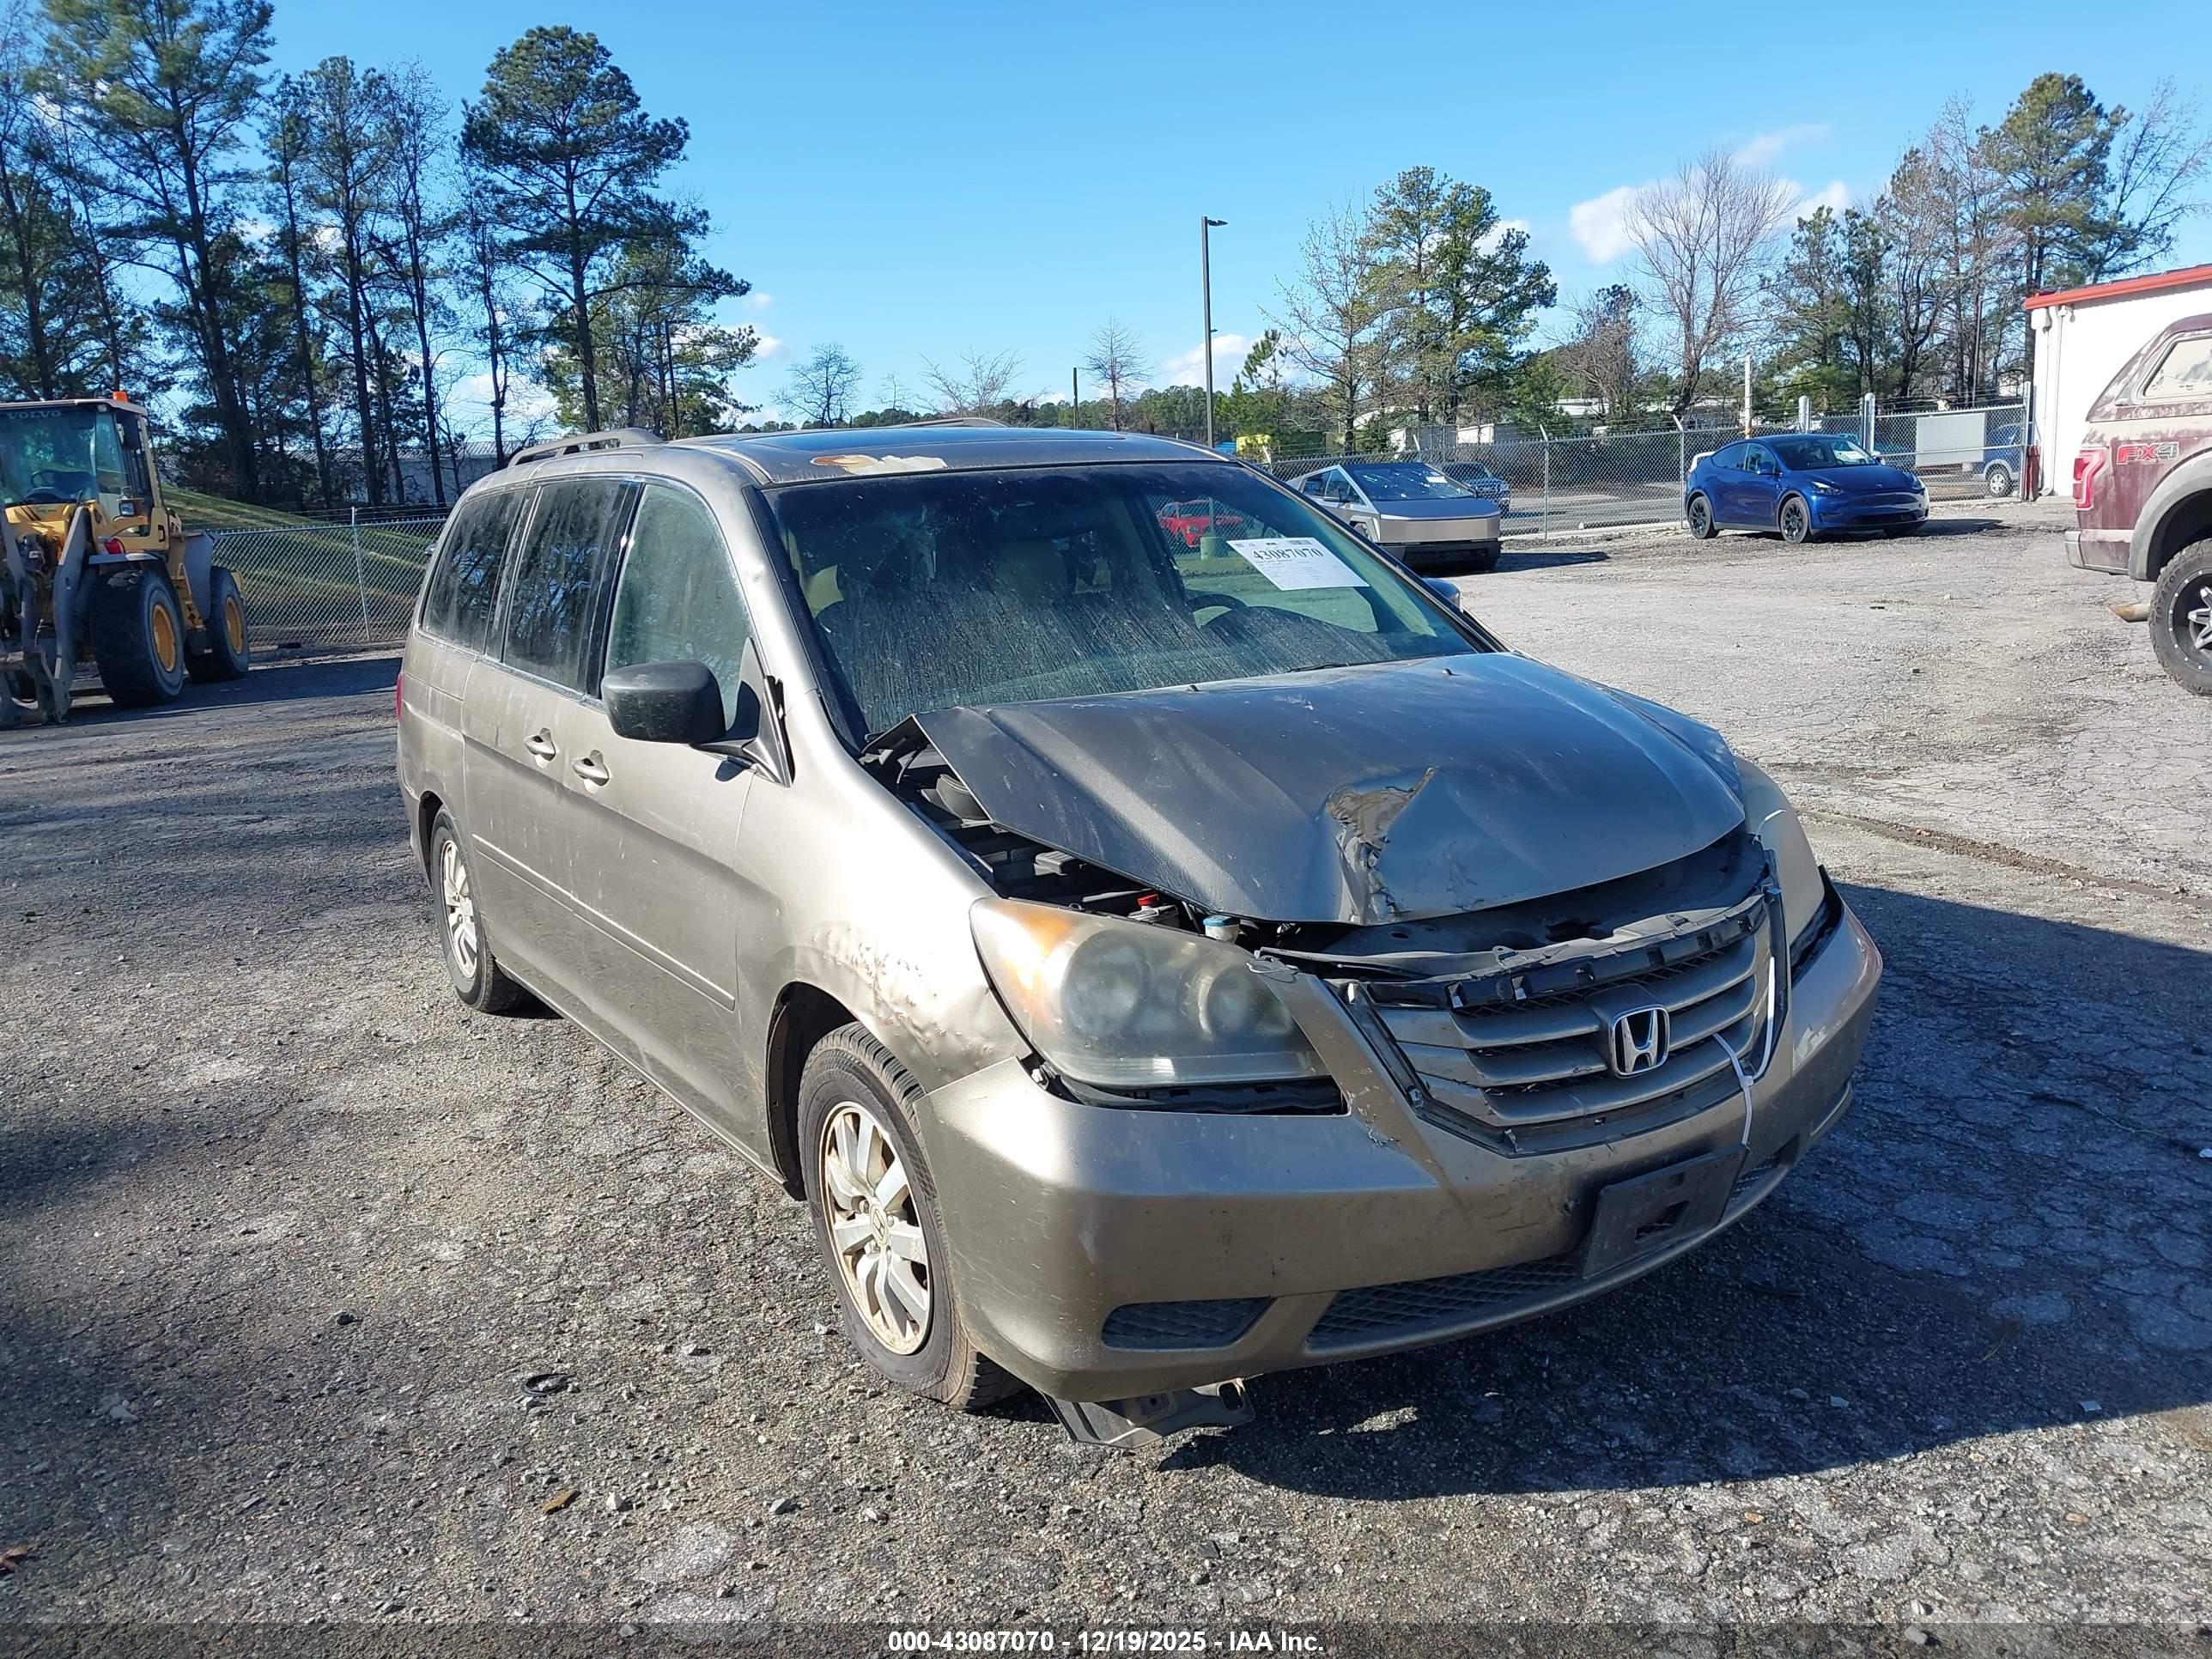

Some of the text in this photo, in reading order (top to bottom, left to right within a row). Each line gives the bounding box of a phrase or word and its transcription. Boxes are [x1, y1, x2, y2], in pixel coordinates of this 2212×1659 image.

[7, 410, 62, 420] VOLVO
[2117, 442, 2179, 465] FX4
[1253, 548, 1324, 561] 43087070
